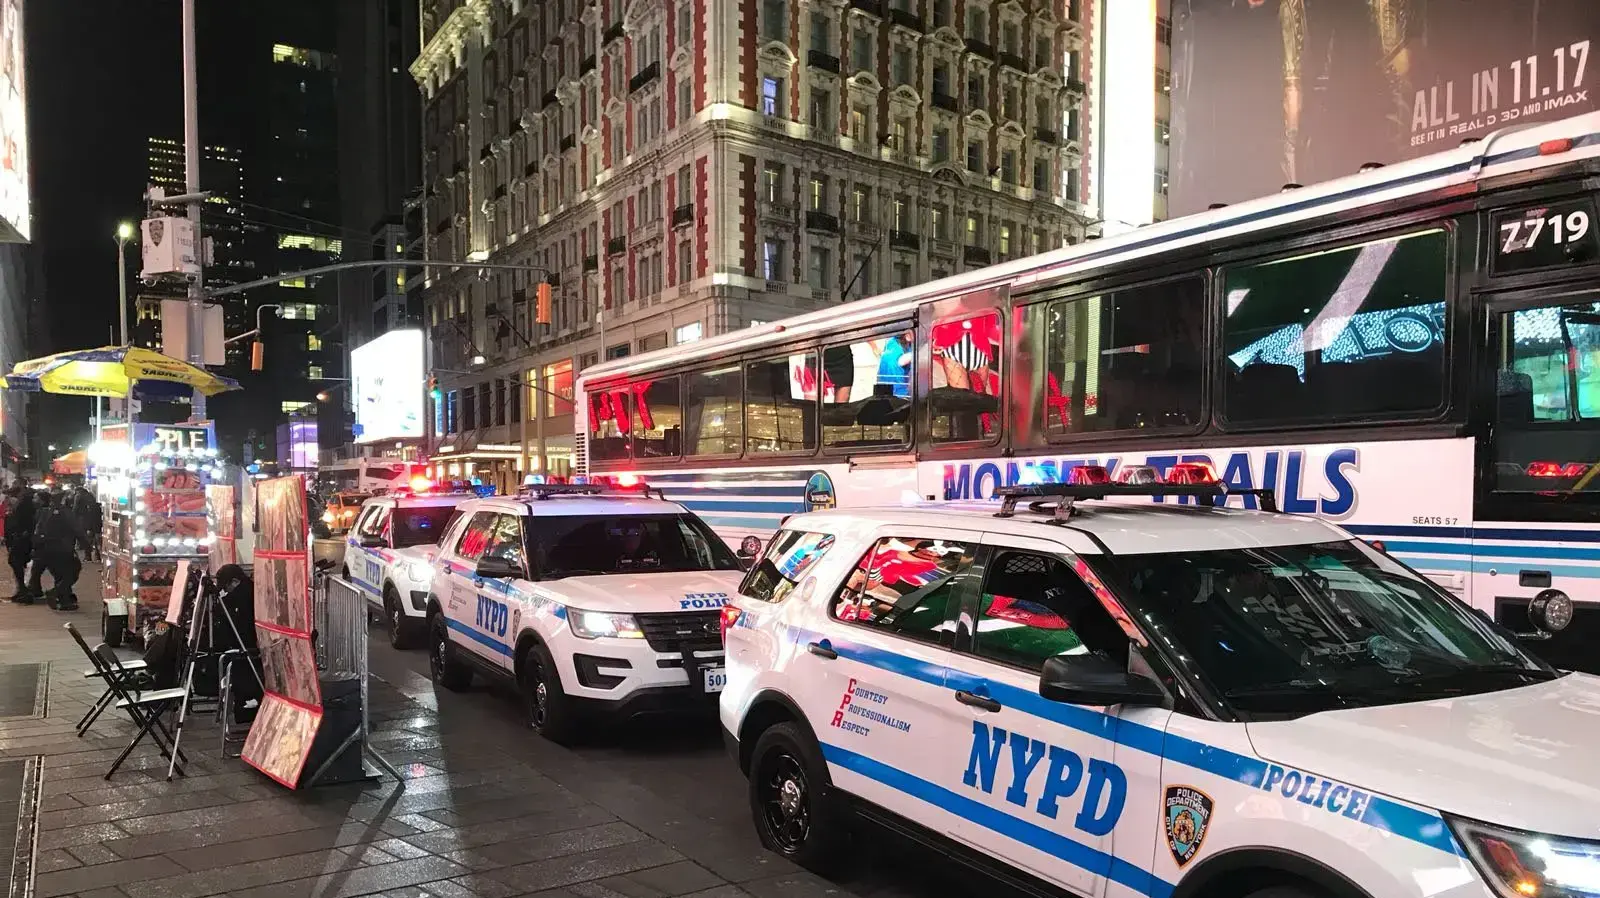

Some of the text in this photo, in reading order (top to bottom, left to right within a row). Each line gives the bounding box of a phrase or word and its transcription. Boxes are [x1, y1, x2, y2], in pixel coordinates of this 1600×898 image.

[1411, 40, 1590, 132] ALL IN 11.17
[1410, 133, 1425, 147] SEE
[1427, 131, 1434, 141] IT
[1436, 128, 1445, 140] IN
[1449, 120, 1484, 136] REAL
[1500, 108, 1520, 122] 3D
[1522, 102, 1541, 117] AND
[1544, 90, 1588, 111] IMAX
[1412, 516, 1442, 525] SEATS
[680, 598, 733, 609] POLIC
[684, 592, 728, 600] NYPD
[476, 594, 508, 637] NYPD
[963, 720, 1128, 837] NYPD
[1262, 764, 1368, 821] POLICE
[1166, 797, 1210, 819] DEPARTMENT
[1176, 788, 1204, 805] POLICE
[1165, 816, 1173, 837] CITY
[1184, 823, 1207, 861] NEW YORK
